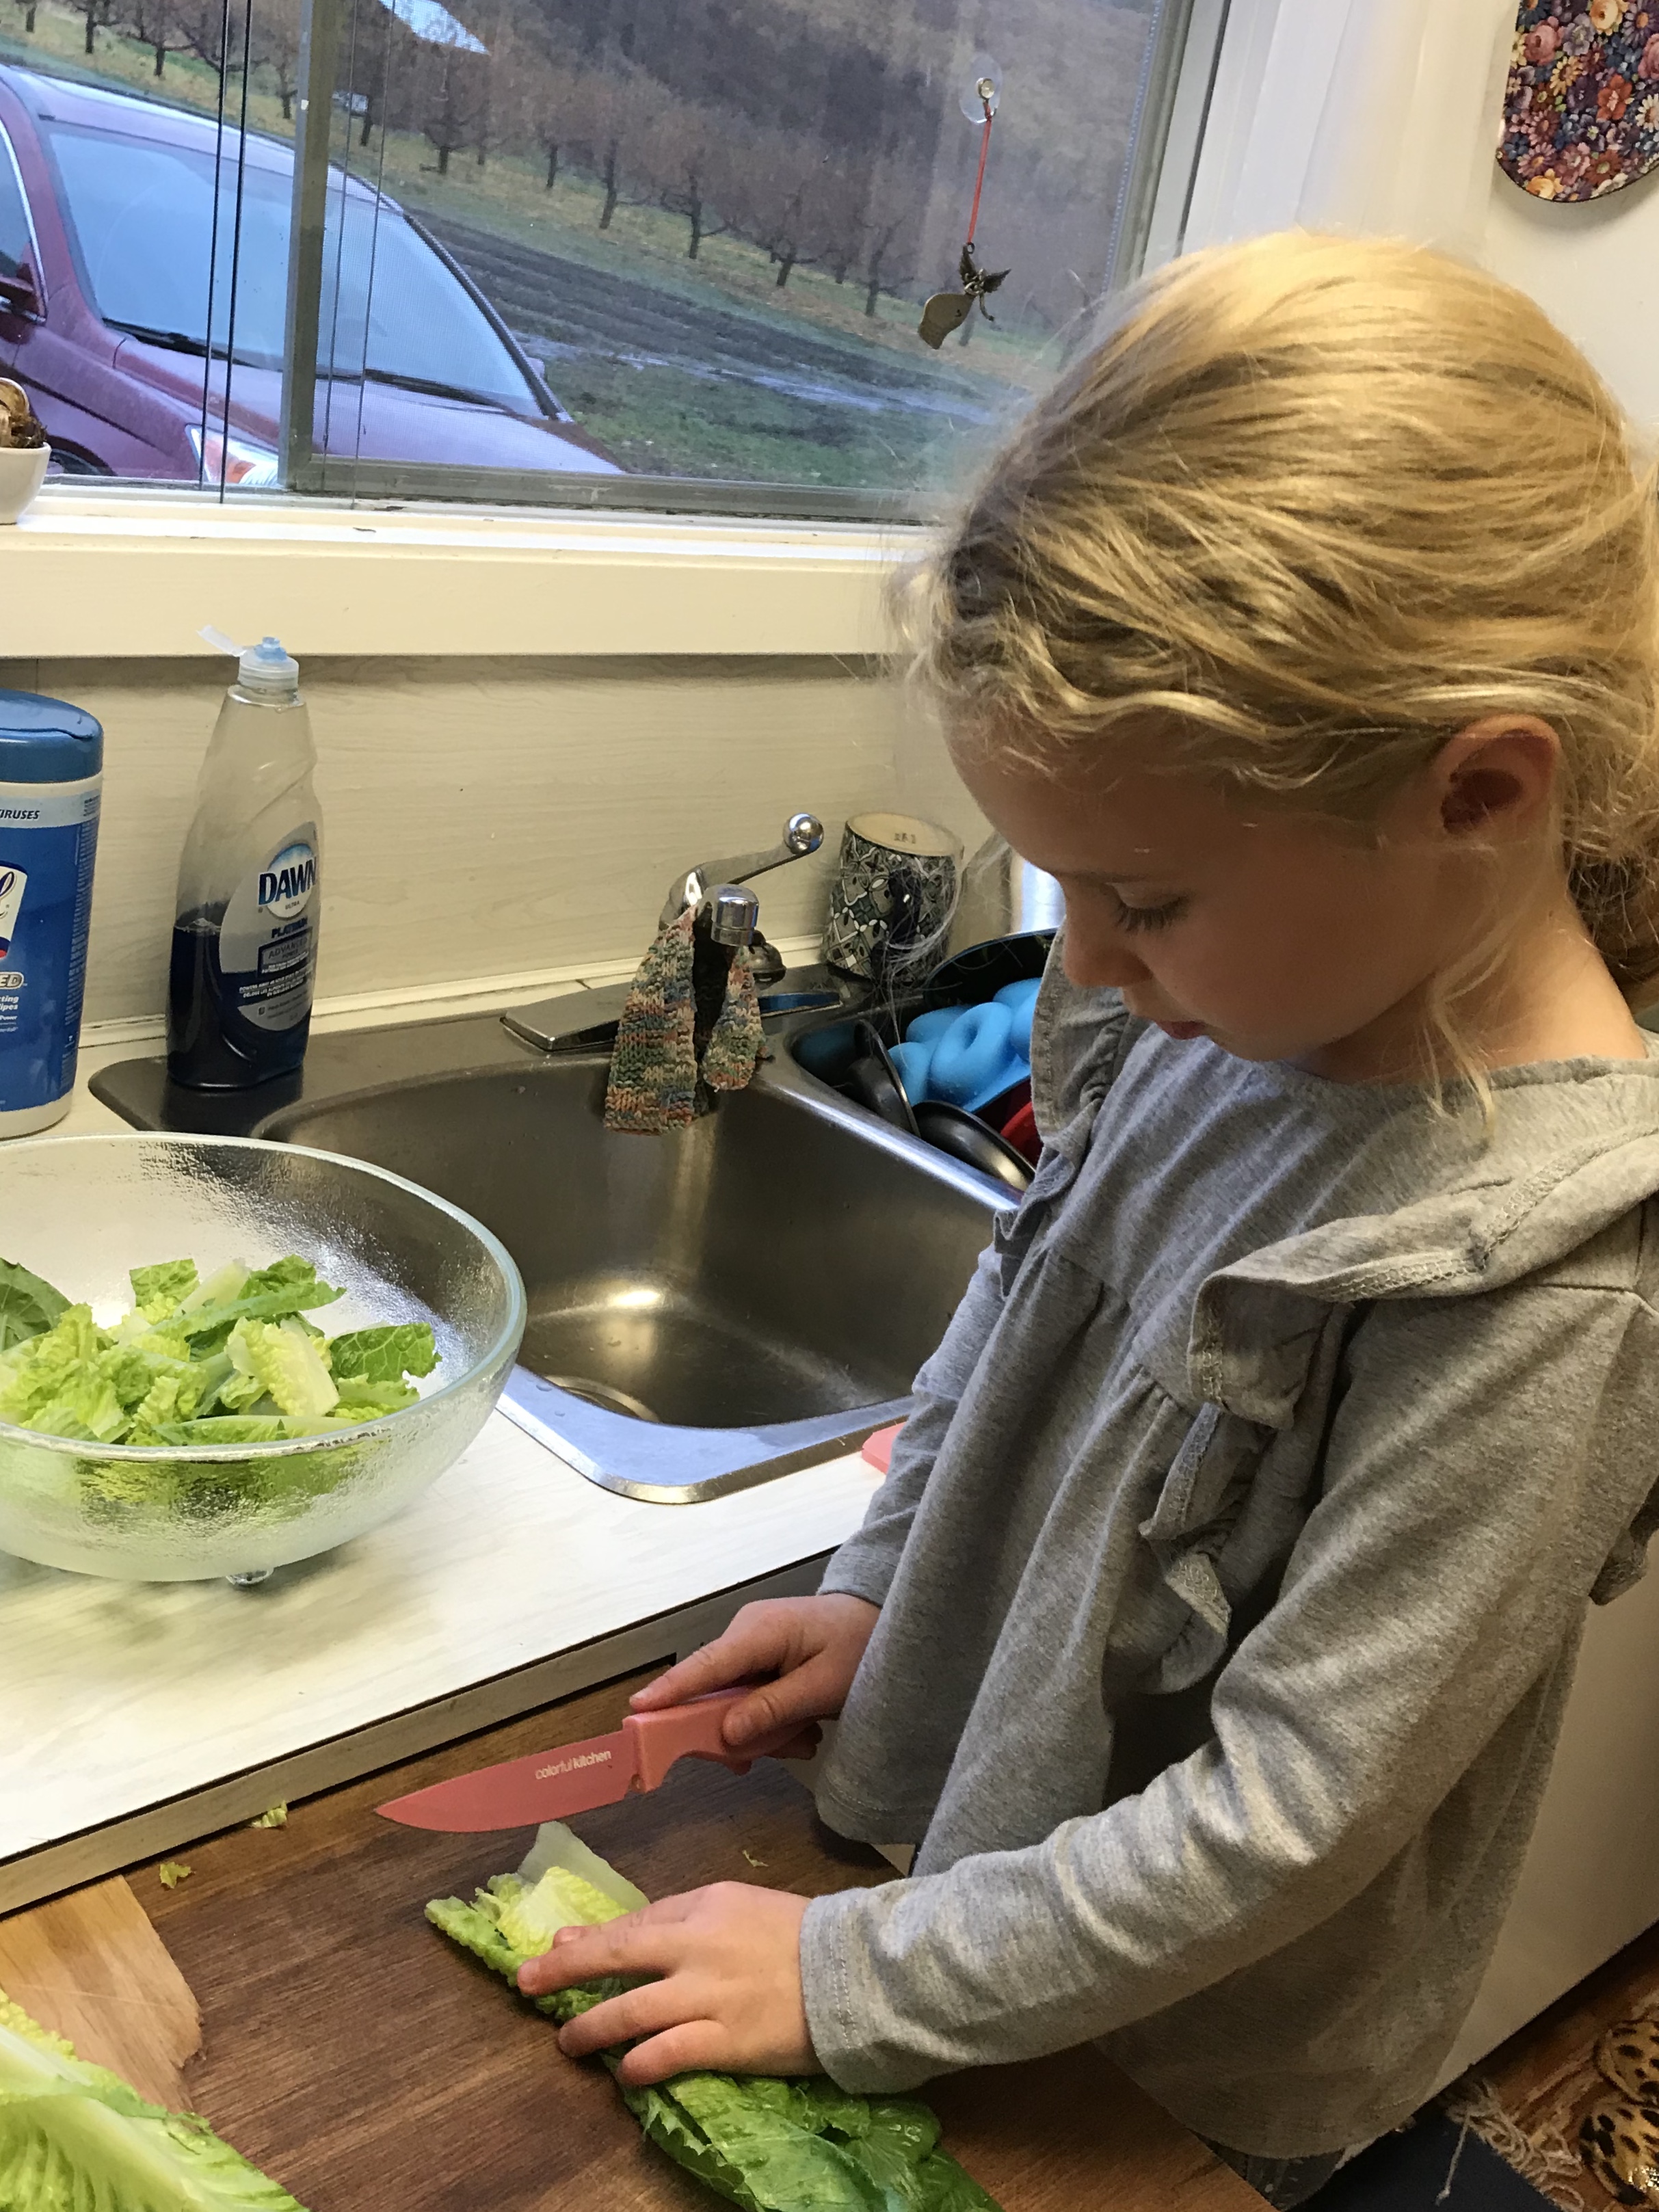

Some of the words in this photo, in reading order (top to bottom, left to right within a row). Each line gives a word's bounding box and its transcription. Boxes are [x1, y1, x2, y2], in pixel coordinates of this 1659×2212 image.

[0, 809, 40, 820] IRUSES
[258, 856, 317, 905] DAWN
[535, 1758, 572, 1779] colorful
[573, 1750, 611, 1769] kitchen
